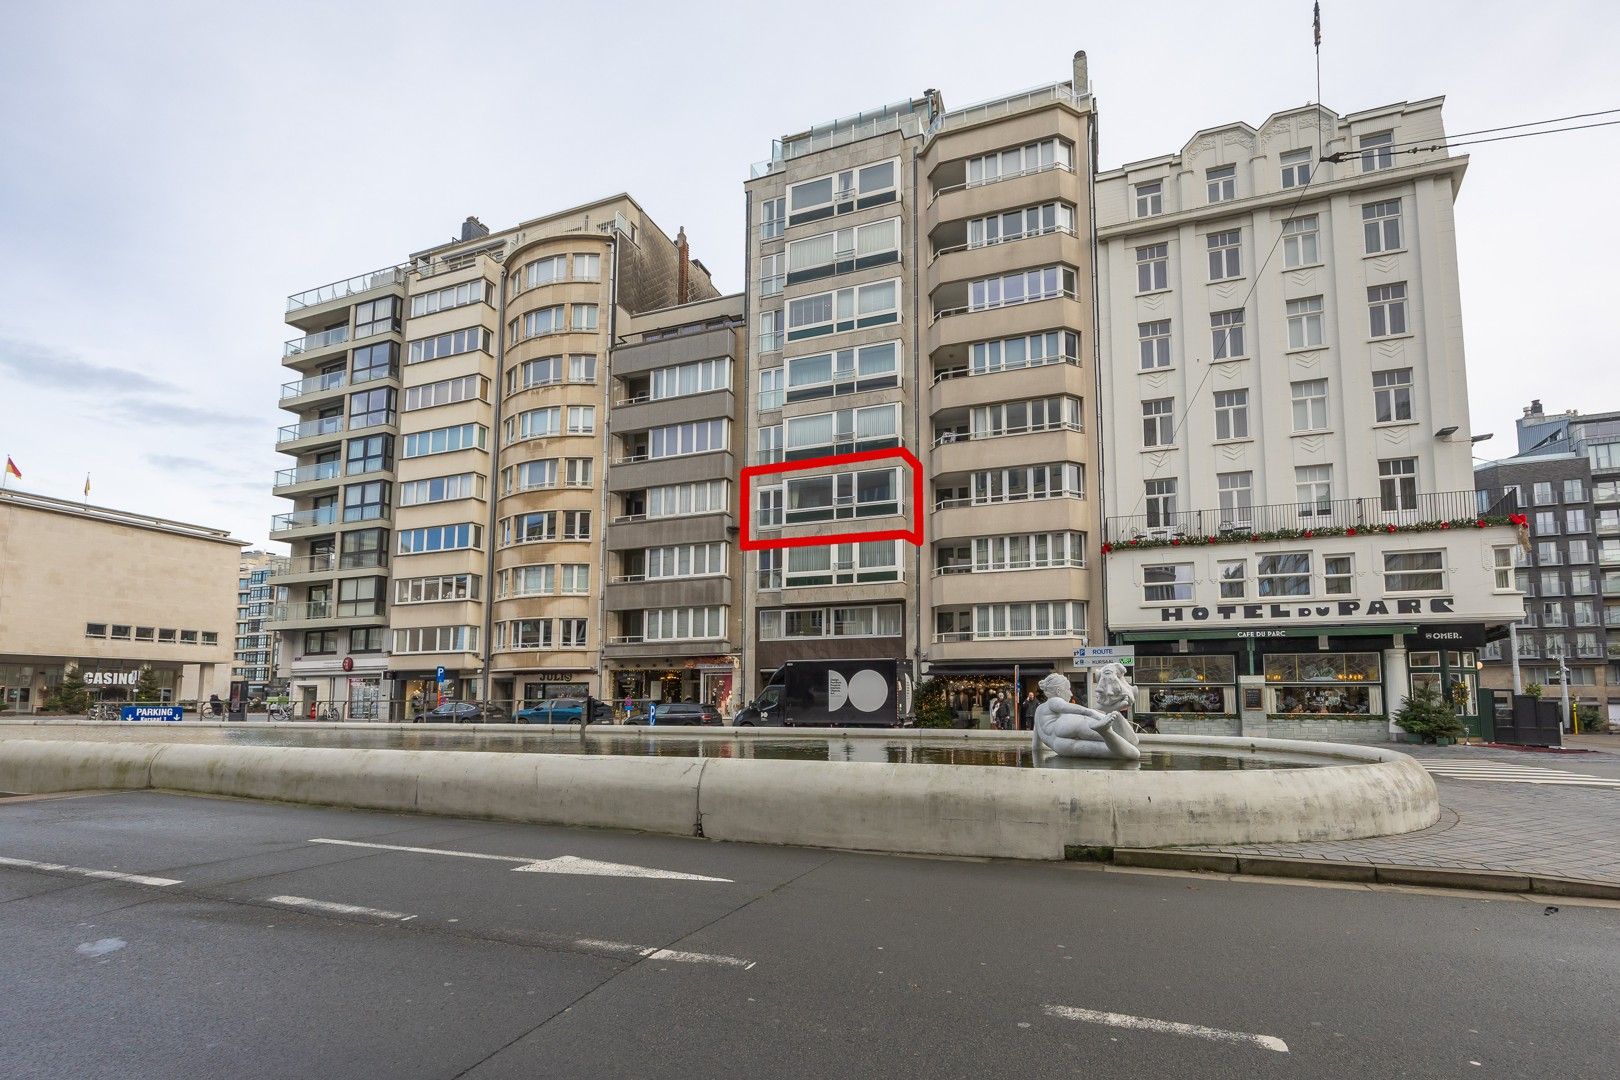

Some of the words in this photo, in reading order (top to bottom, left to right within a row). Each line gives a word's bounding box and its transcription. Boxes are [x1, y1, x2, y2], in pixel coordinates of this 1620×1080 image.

[1161, 604, 1290, 621] HOTEL
[1298, 606, 1330, 617] DU
[1338, 598, 1454, 616] PARC
[438, 667, 444, 677] P
[538, 672, 574, 682] JULIS
[83, 672, 136, 684] CASINO
[136, 708, 173, 716] PARKING
